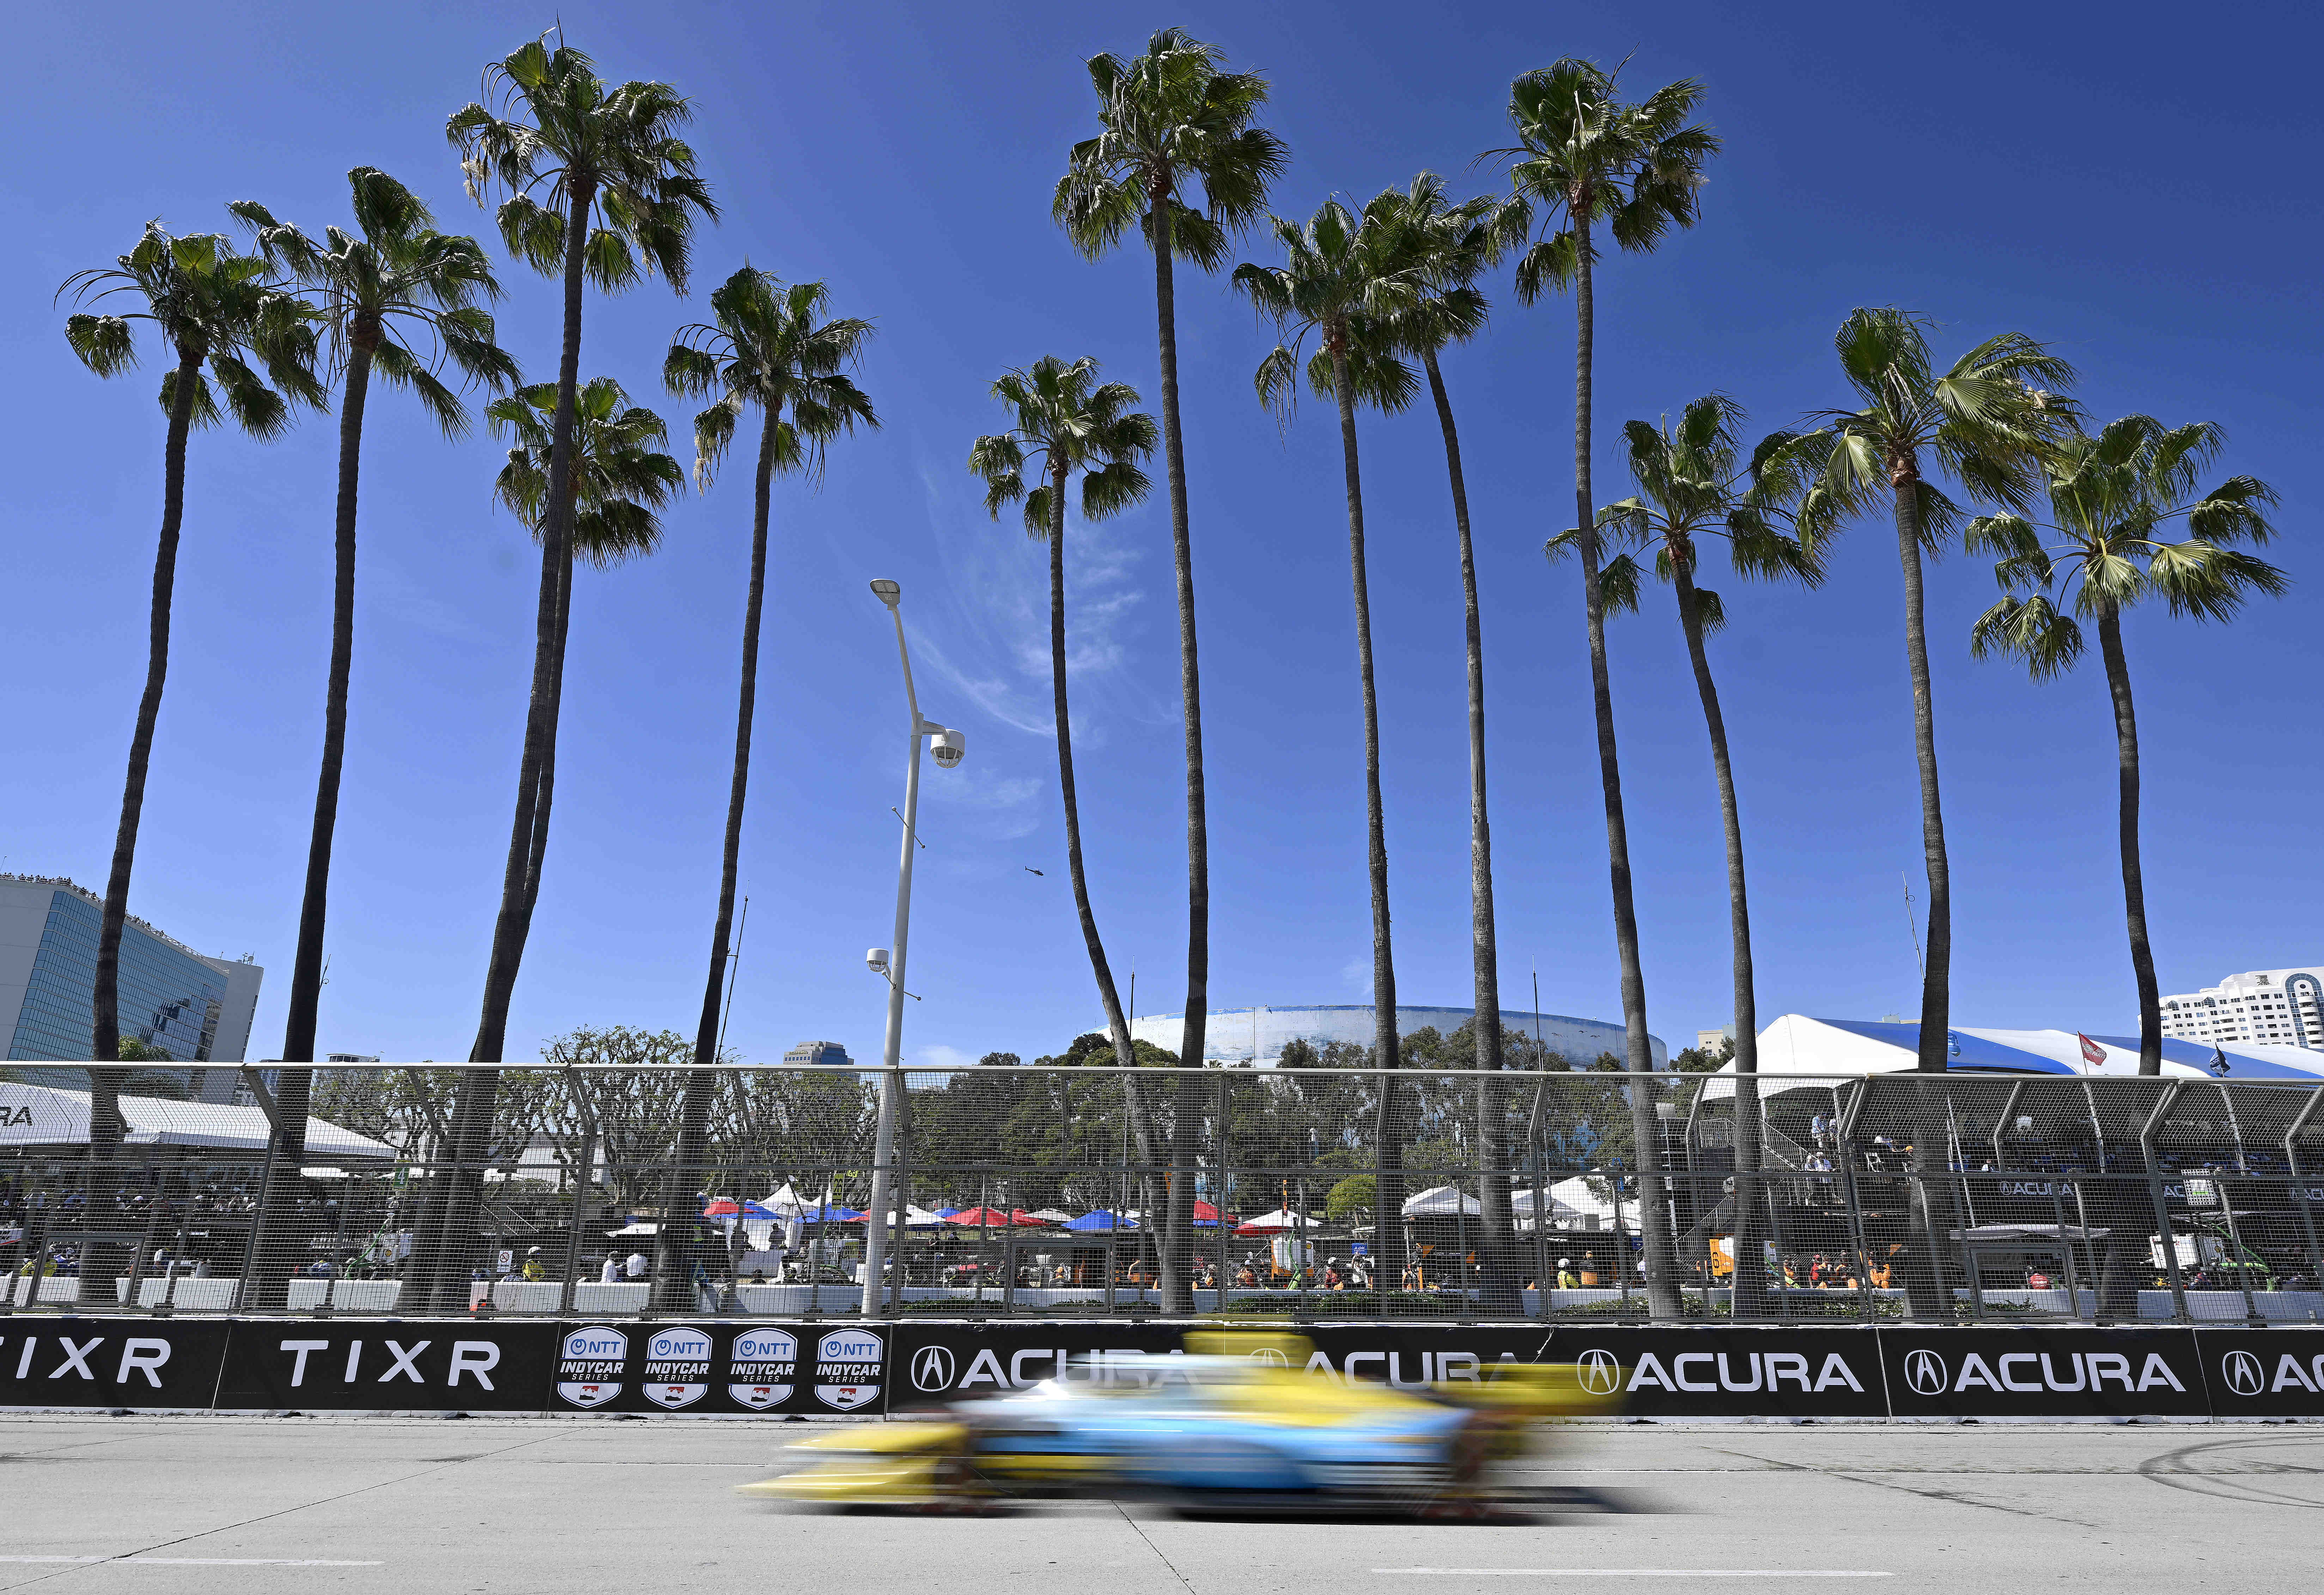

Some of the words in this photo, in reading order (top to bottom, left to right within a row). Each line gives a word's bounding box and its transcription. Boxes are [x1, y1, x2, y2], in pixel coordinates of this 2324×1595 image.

[2092, 1051, 2106, 1059] PARTS
[397, 1168, 405, 1184] 4
[589, 1341, 620, 1353] NTT
[674, 1342, 705, 1354] NTT
[759, 1343, 790, 1355] NTT
[844, 1344, 876, 1355] NTT
[0, 1337, 171, 1388] IXR
[280, 1340, 500, 1390] TIXR
[560, 1362, 623, 1374] INDYCAR
[645, 1363, 709, 1374] INDYCAR
[730, 1363, 795, 1375] INDYCAR
[816, 1364, 881, 1376] INDYCAR
[1626, 1353, 1864, 1392] ACURA
[1954, 1353, 2186, 1391] ACURA
